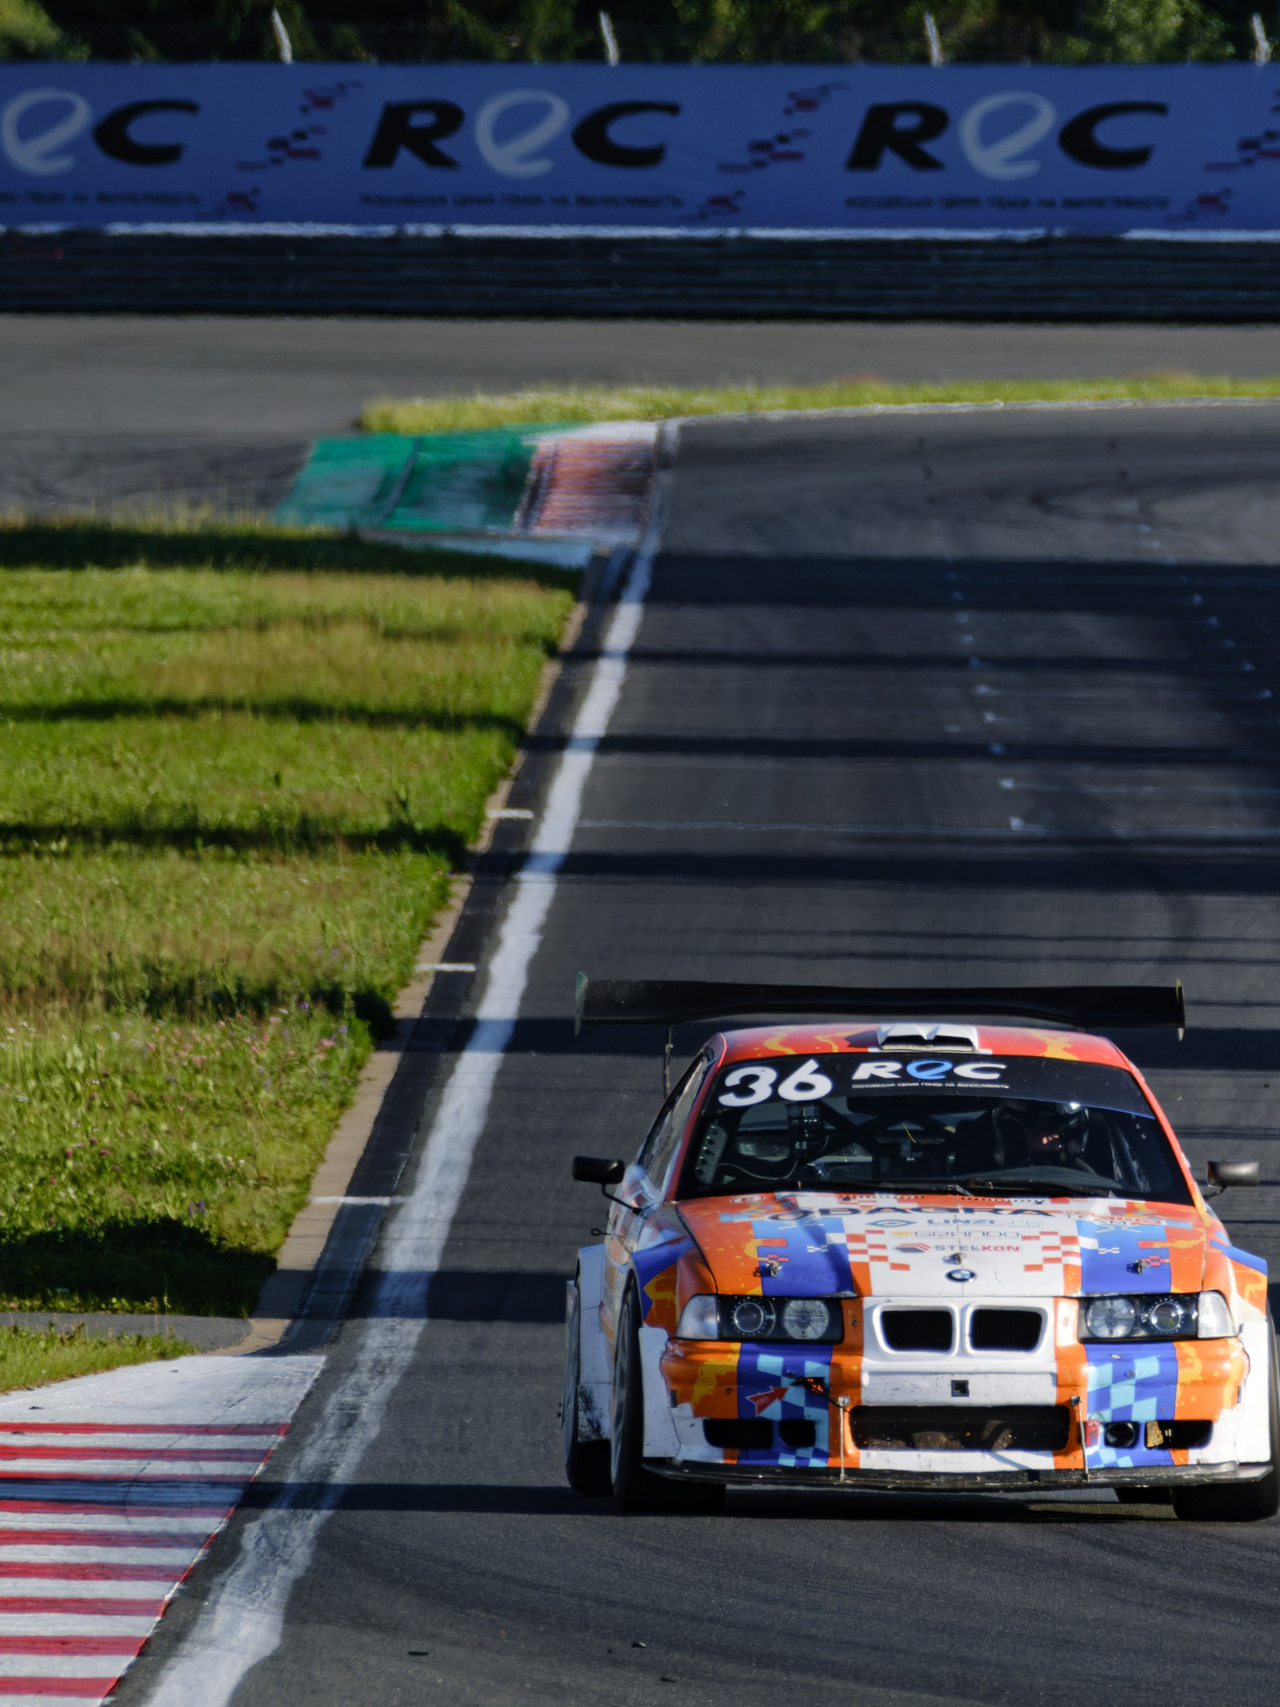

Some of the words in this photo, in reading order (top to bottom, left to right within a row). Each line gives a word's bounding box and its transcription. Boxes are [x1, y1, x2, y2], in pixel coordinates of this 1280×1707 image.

[2, 86, 200, 176] eC
[717, 1058, 834, 1107] 36
[934, 1244, 1020, 1252] STELKON
